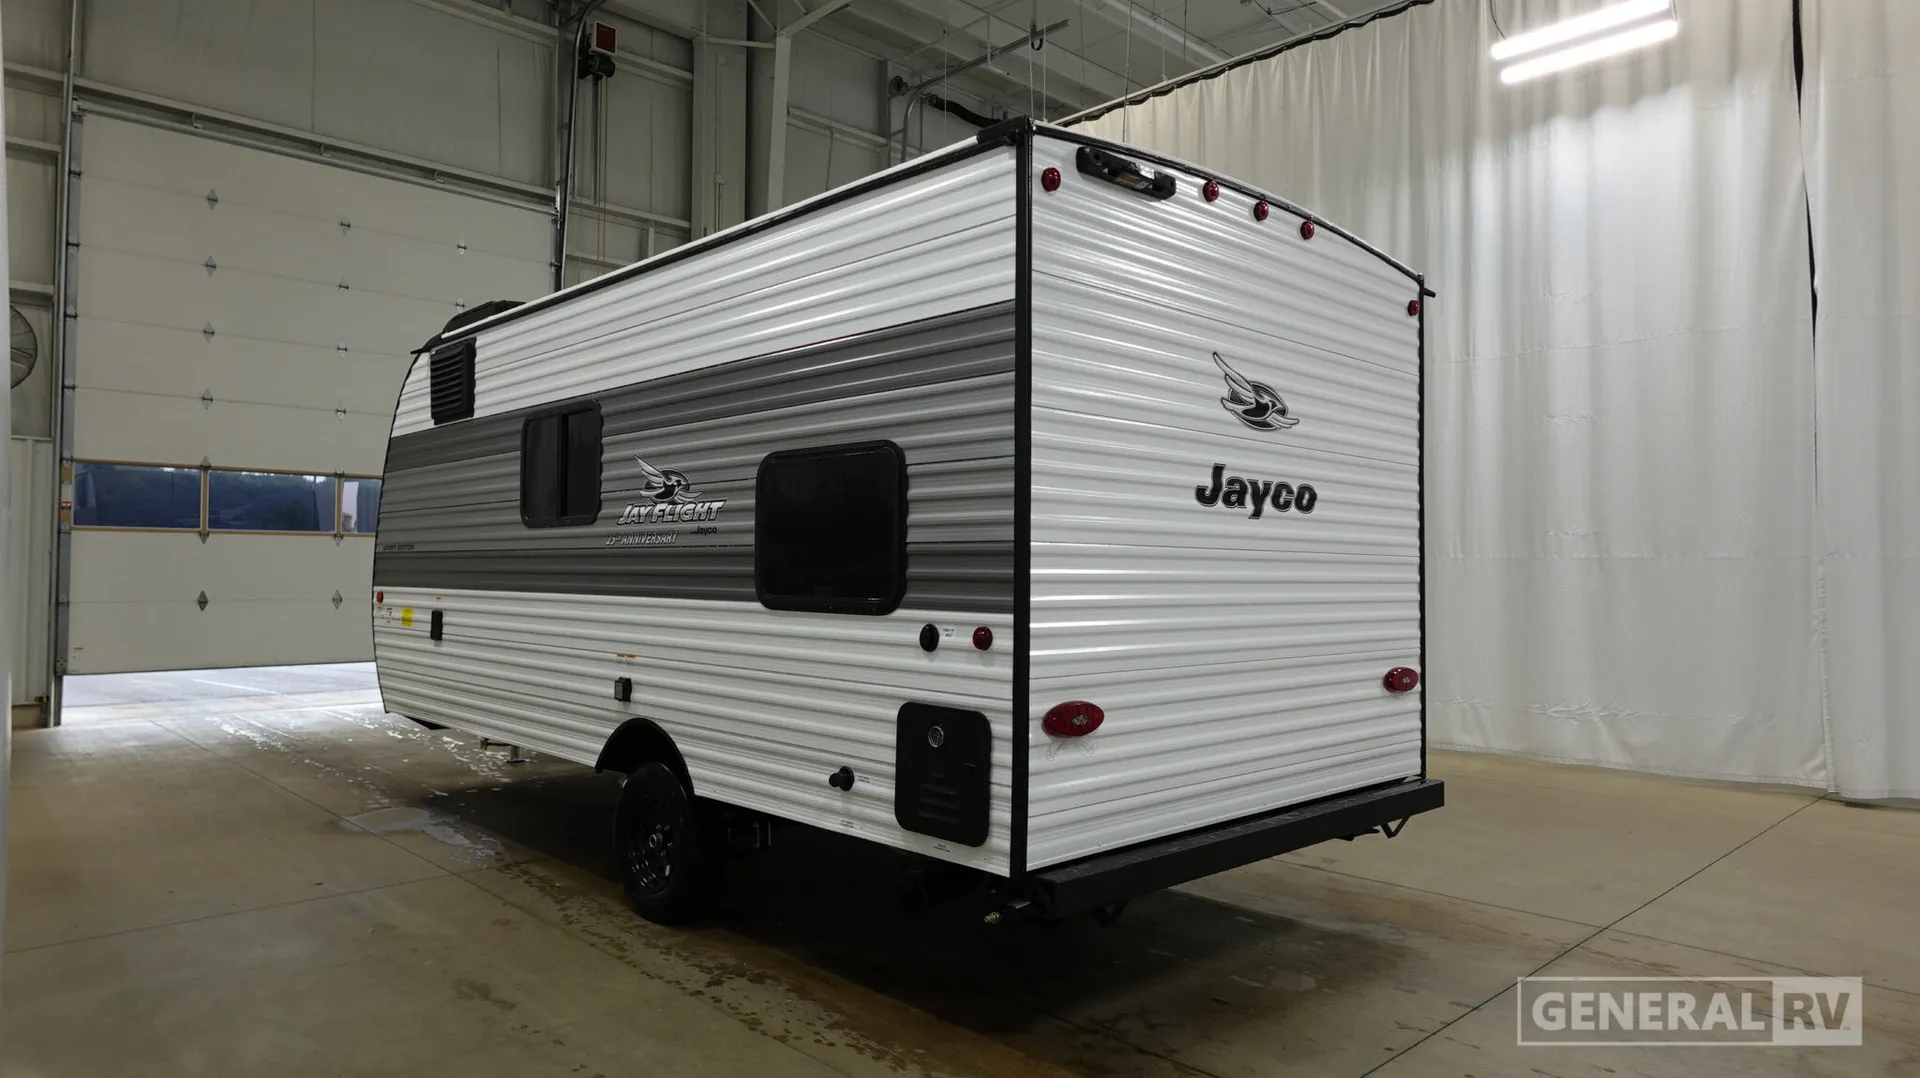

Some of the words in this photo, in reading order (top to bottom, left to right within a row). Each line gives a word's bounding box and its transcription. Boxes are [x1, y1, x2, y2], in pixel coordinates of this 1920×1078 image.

[1195, 463, 1318, 519] Jayco
[617, 503, 653, 525] JAY
[650, 499, 727, 523] FLIGHT
[620, 530, 679, 546] ANNIVERSARY
